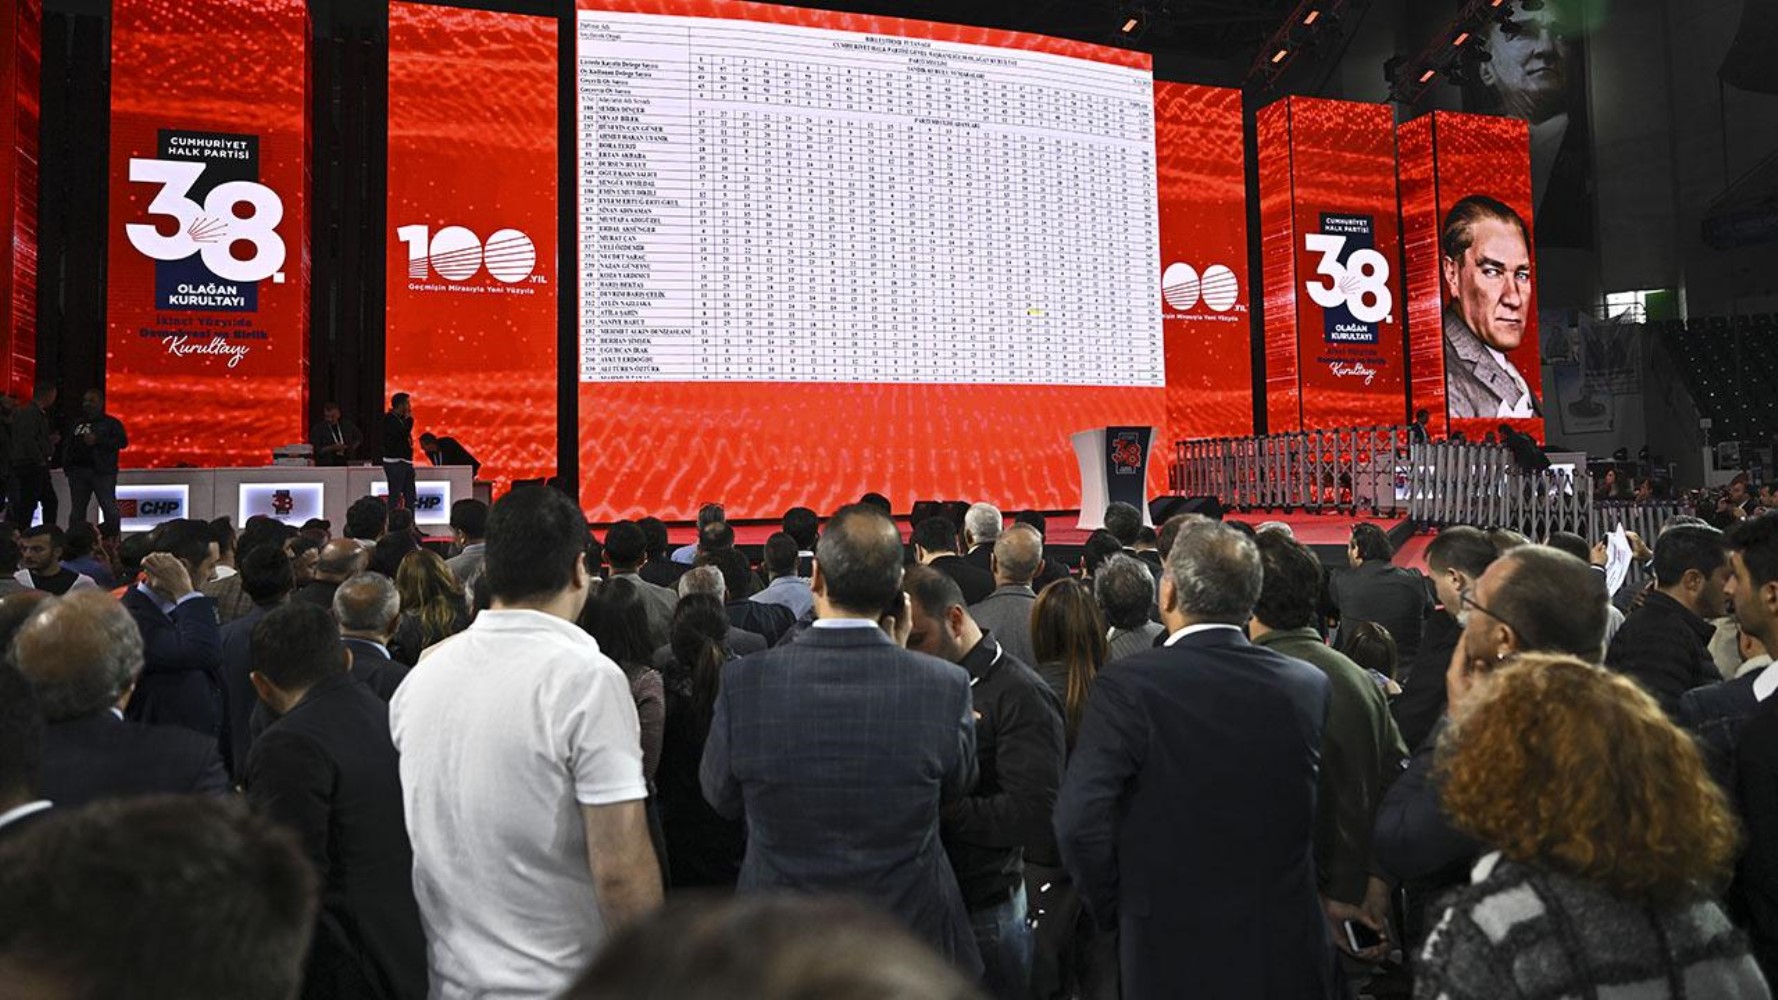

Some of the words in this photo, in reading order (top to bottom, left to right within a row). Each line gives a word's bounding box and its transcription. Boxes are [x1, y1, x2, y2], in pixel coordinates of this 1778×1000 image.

[170, 136, 247, 149] CUMHURİYET
[168, 146, 200, 156] HALK
[204, 149, 249, 159] PARTİSİ
[397, 224, 536, 283] 100
[177, 283, 237, 295] OLAĞAN
[1162, 262, 1238, 312] 00
[169, 295, 245, 307] KURULTAYI
[1335, 322, 1368, 332] OLAĞAN
[1331, 332, 1372, 341] KURULTAYI
[162, 335, 250, 368] Kurultayı
[140, 501, 180, 514] CHP
[416, 496, 441, 509] HP
